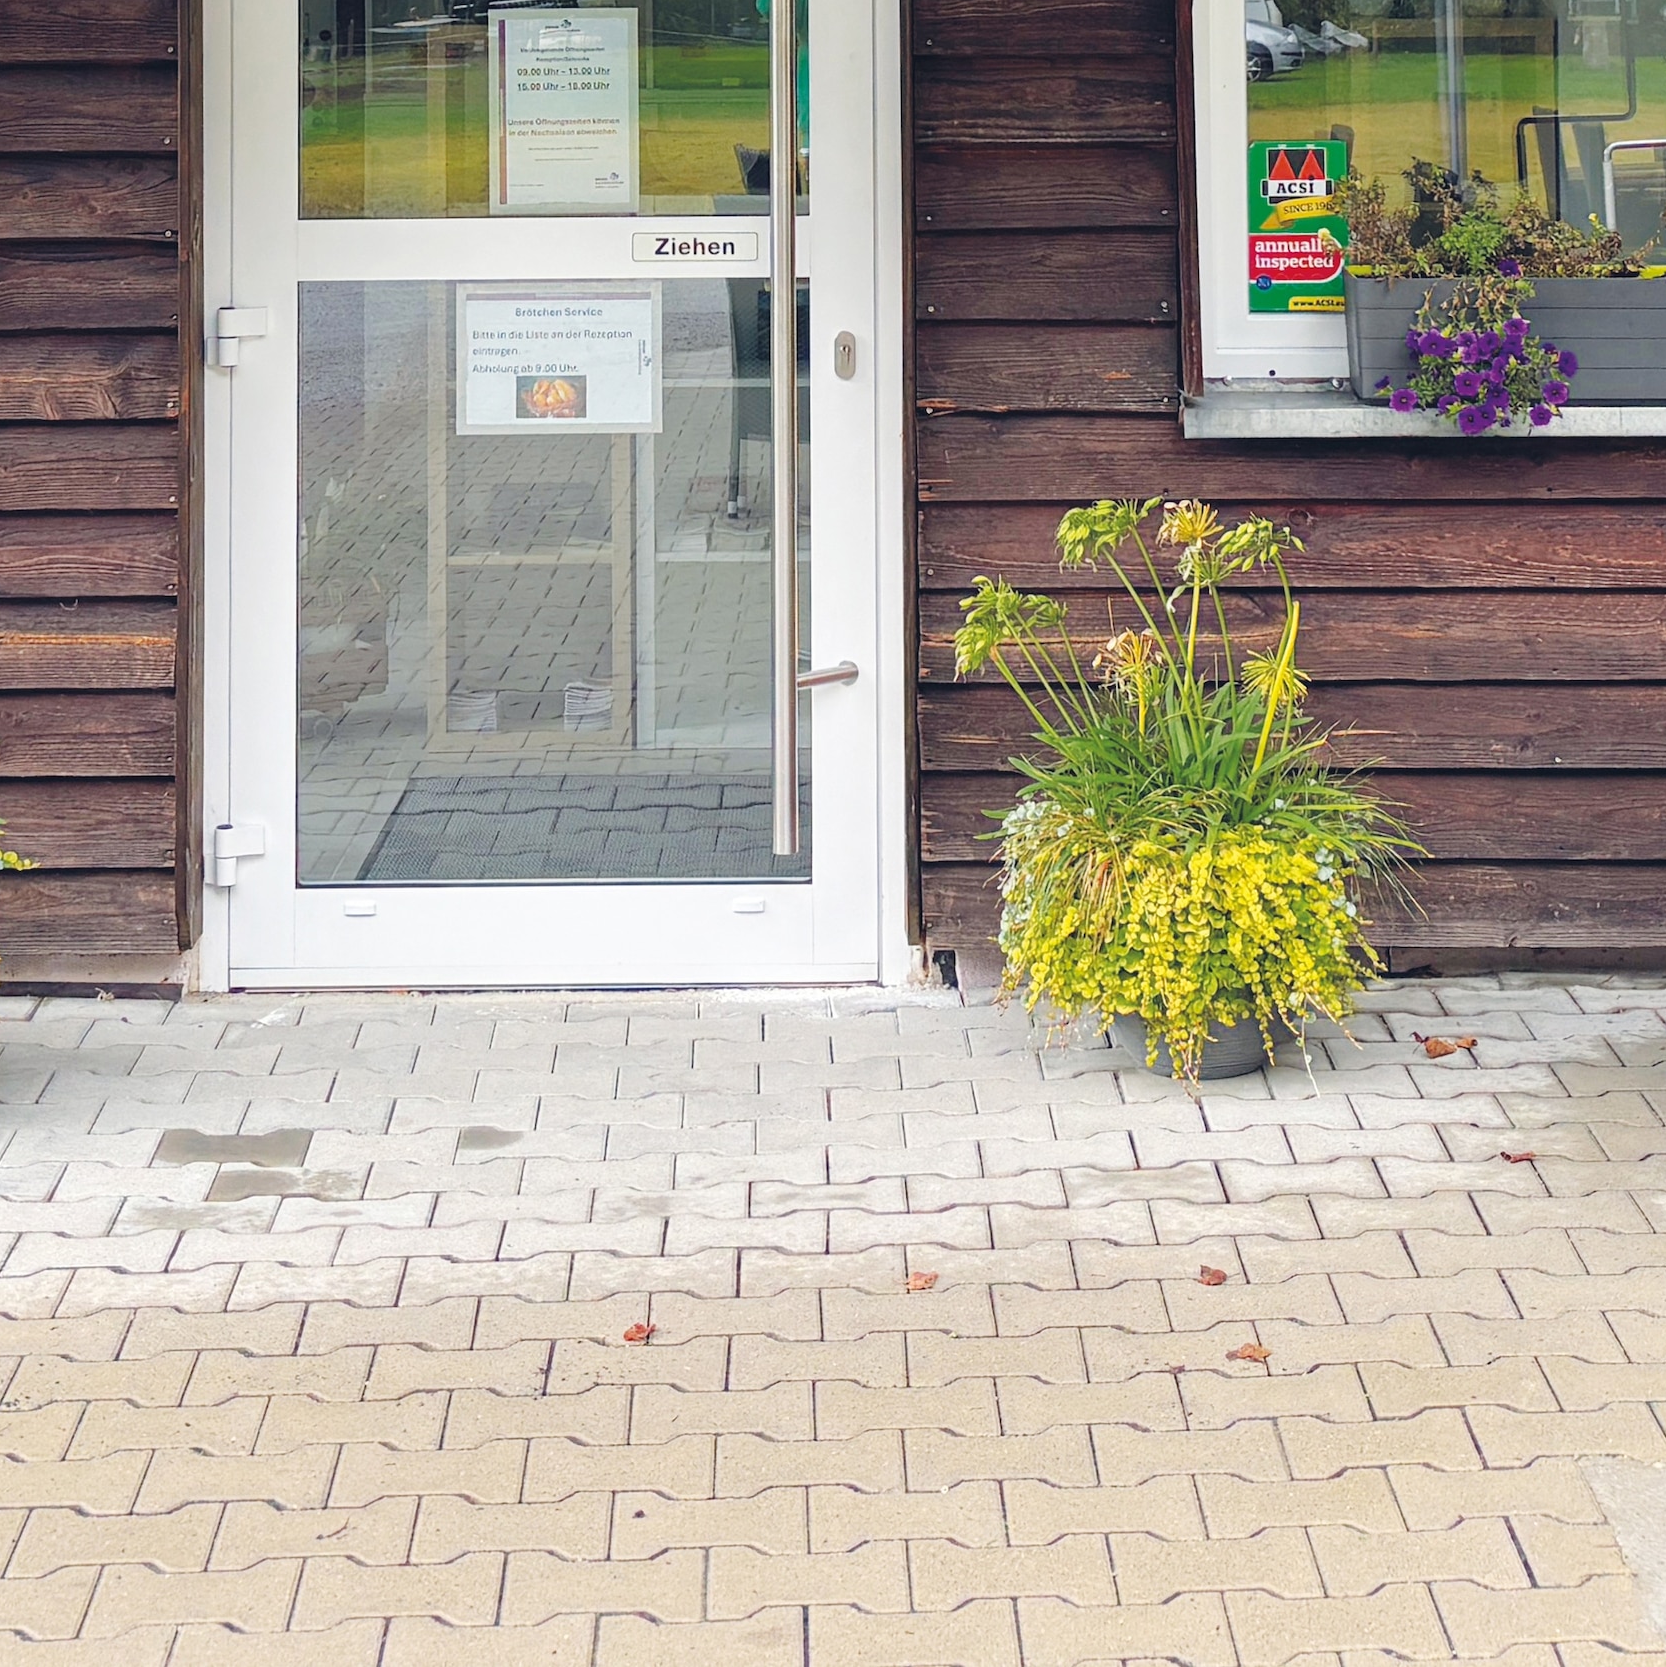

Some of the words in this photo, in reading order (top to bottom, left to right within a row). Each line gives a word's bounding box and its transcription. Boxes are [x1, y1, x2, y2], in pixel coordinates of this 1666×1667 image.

[543, 67, 559, 76] Uhr
[594, 67, 610, 75] Uhr
[543, 82, 559, 91] Uhr
[593, 81, 610, 90] Uhr
[1277, 182, 1314, 194] ACSI
[1284, 202, 1313, 215] SINCE
[654, 237, 735, 256] Ziehen
[1255, 238, 1325, 253] annuall
[1255, 254, 1334, 271] inspected
[515, 307, 562, 317] Brötchen
[564, 307, 603, 317] Service
[472, 330, 495, 340] Bitte
[497, 330, 507, 339] in
[508, 330, 523, 340] die
[526, 330, 549, 340] Liste
[550, 331, 564, 339] an
[565, 330, 581, 339] der
[584, 330, 633, 340] Rezeption
[472, 364, 519, 375] Abholung
[521, 364, 533, 373] ab
